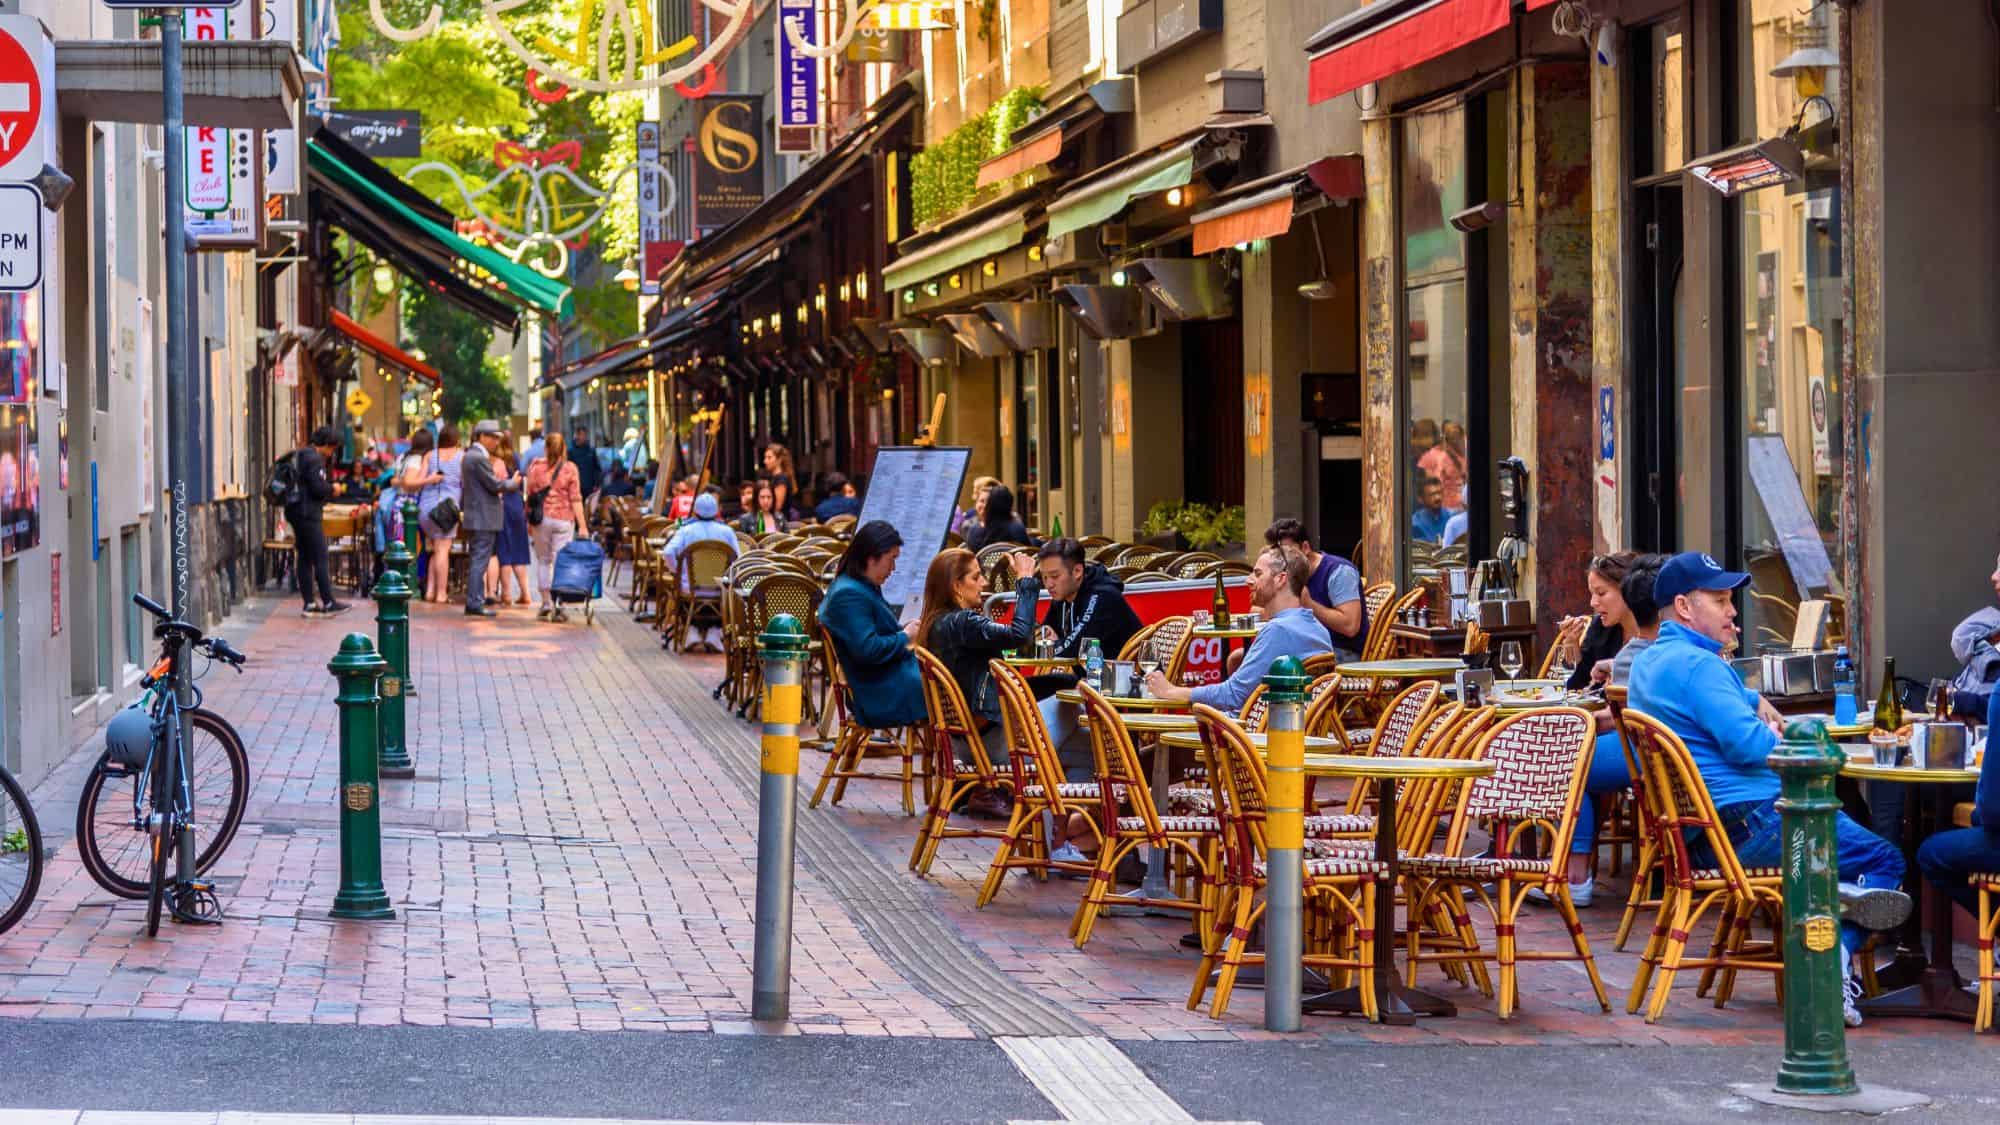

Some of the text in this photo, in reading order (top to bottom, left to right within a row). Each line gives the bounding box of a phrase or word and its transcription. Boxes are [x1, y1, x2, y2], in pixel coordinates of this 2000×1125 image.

[791, 10, 809, 123] JEELLERS
[350, 120, 403, 144] amigos
[1, 234, 28, 250] PM
